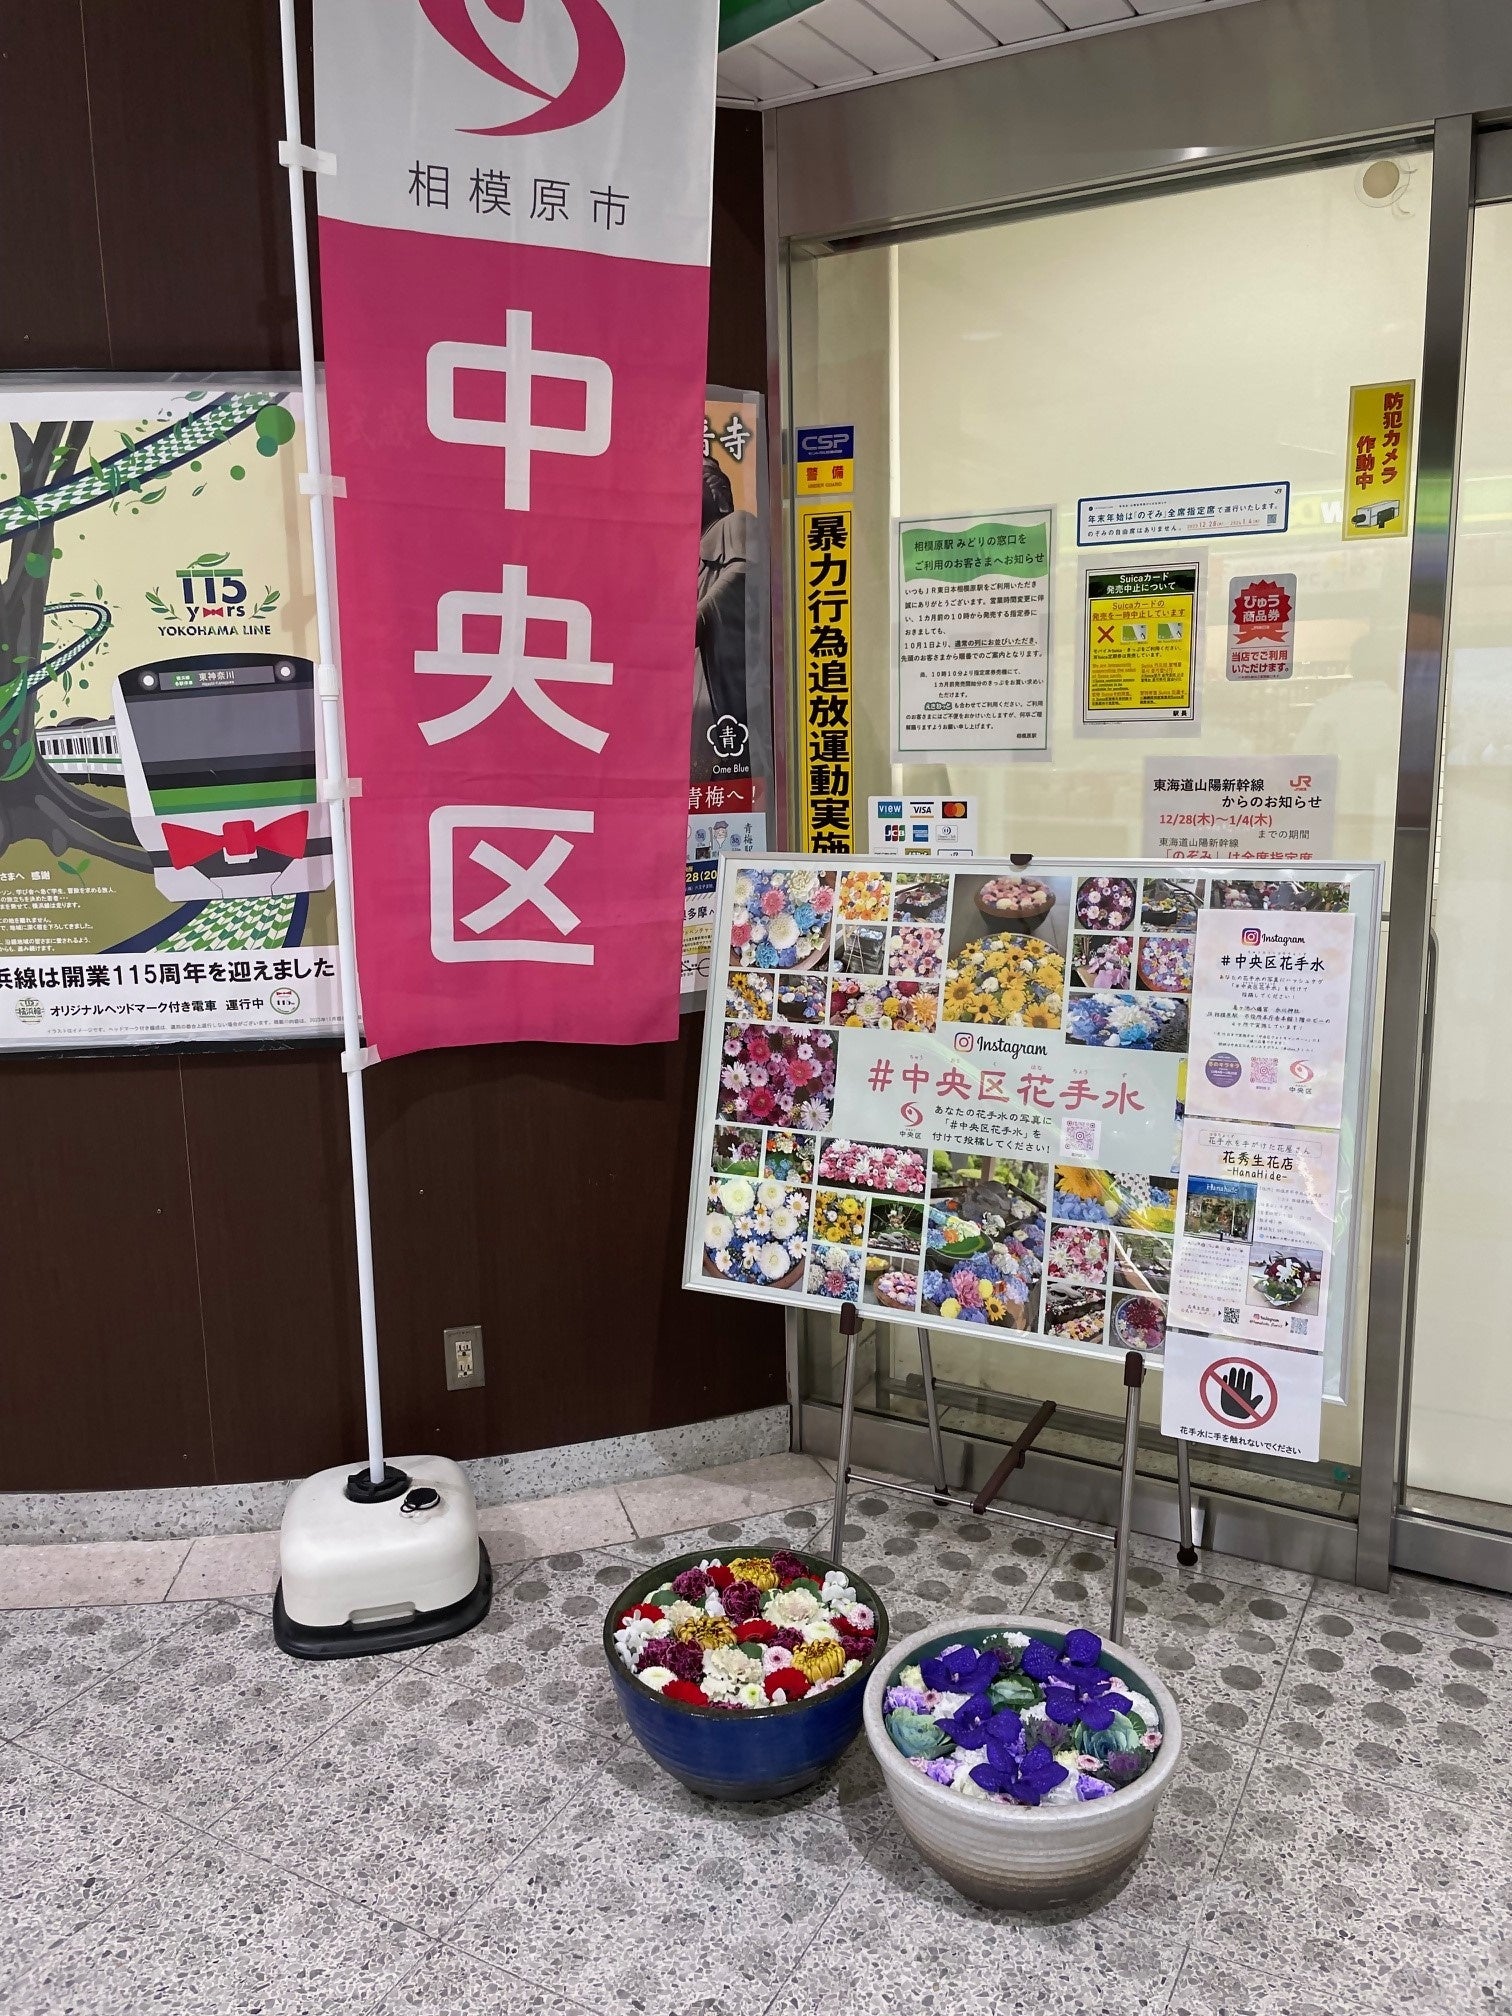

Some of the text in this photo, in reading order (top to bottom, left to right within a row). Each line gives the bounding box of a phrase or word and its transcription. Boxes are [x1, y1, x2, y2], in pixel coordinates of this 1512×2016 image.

[407, 159, 630, 230] 相模原市
[801, 433, 850, 451] CSP
[1381, 391, 1404, 485] 防犯カメラ
[1355, 435, 1376, 491] 作動中
[914, 533, 1027, 552] 相模原駅 みどりの窓口を
[914, 552, 1045, 571] ご利用のお客さまへお知らせ
[176, 568, 247, 605] 115
[1119, 571, 1169, 584] Suicaカード
[1106, 581, 1176, 595] 発売中止について
[1243, 593, 1280, 609] びゅう
[1242, 608, 1281, 623] 商品券
[158, 625, 271, 637] YOKOHAMA LINE
[413, 308, 614, 966] 中央区
[1231, 650, 1288, 662] 当店でご利用
[1231, 662, 1289, 674] いただけます。
[718, 725, 737, 750] 青
[713, 763, 750, 775] Ome Blue
[1153, 778, 1265, 792] 東海道山陽新幹線
[1289, 775, 1312, 788] JR
[913, 806, 932, 814] VISA
[1221, 795, 1323, 809] からのお知らせ
[1158, 837, 1239, 848] 東海道山陽新幹線
[1258, 829, 1310, 840] までの期間
[1261, 933, 1306, 947] Instagram
[1220, 954, 1326, 973] #中央区花手水
[50, 997, 265, 1017] オリジナルヘッドマーク付き電車 運行中
[976, 1035, 1048, 1060] Instagram
[867, 1058, 1146, 1116] #中央区花手水
[934, 1105, 1052, 1126] あなたの花手水の写真に
[899, 1130, 922, 1140] 中央区
[1208, 1136, 1311, 1155] 花手水を手がけた花屋さん
[1222, 1150, 1294, 1171] 花秀生花店
[1179, 1426, 1302, 1456] 花手水に手を触れないでください
